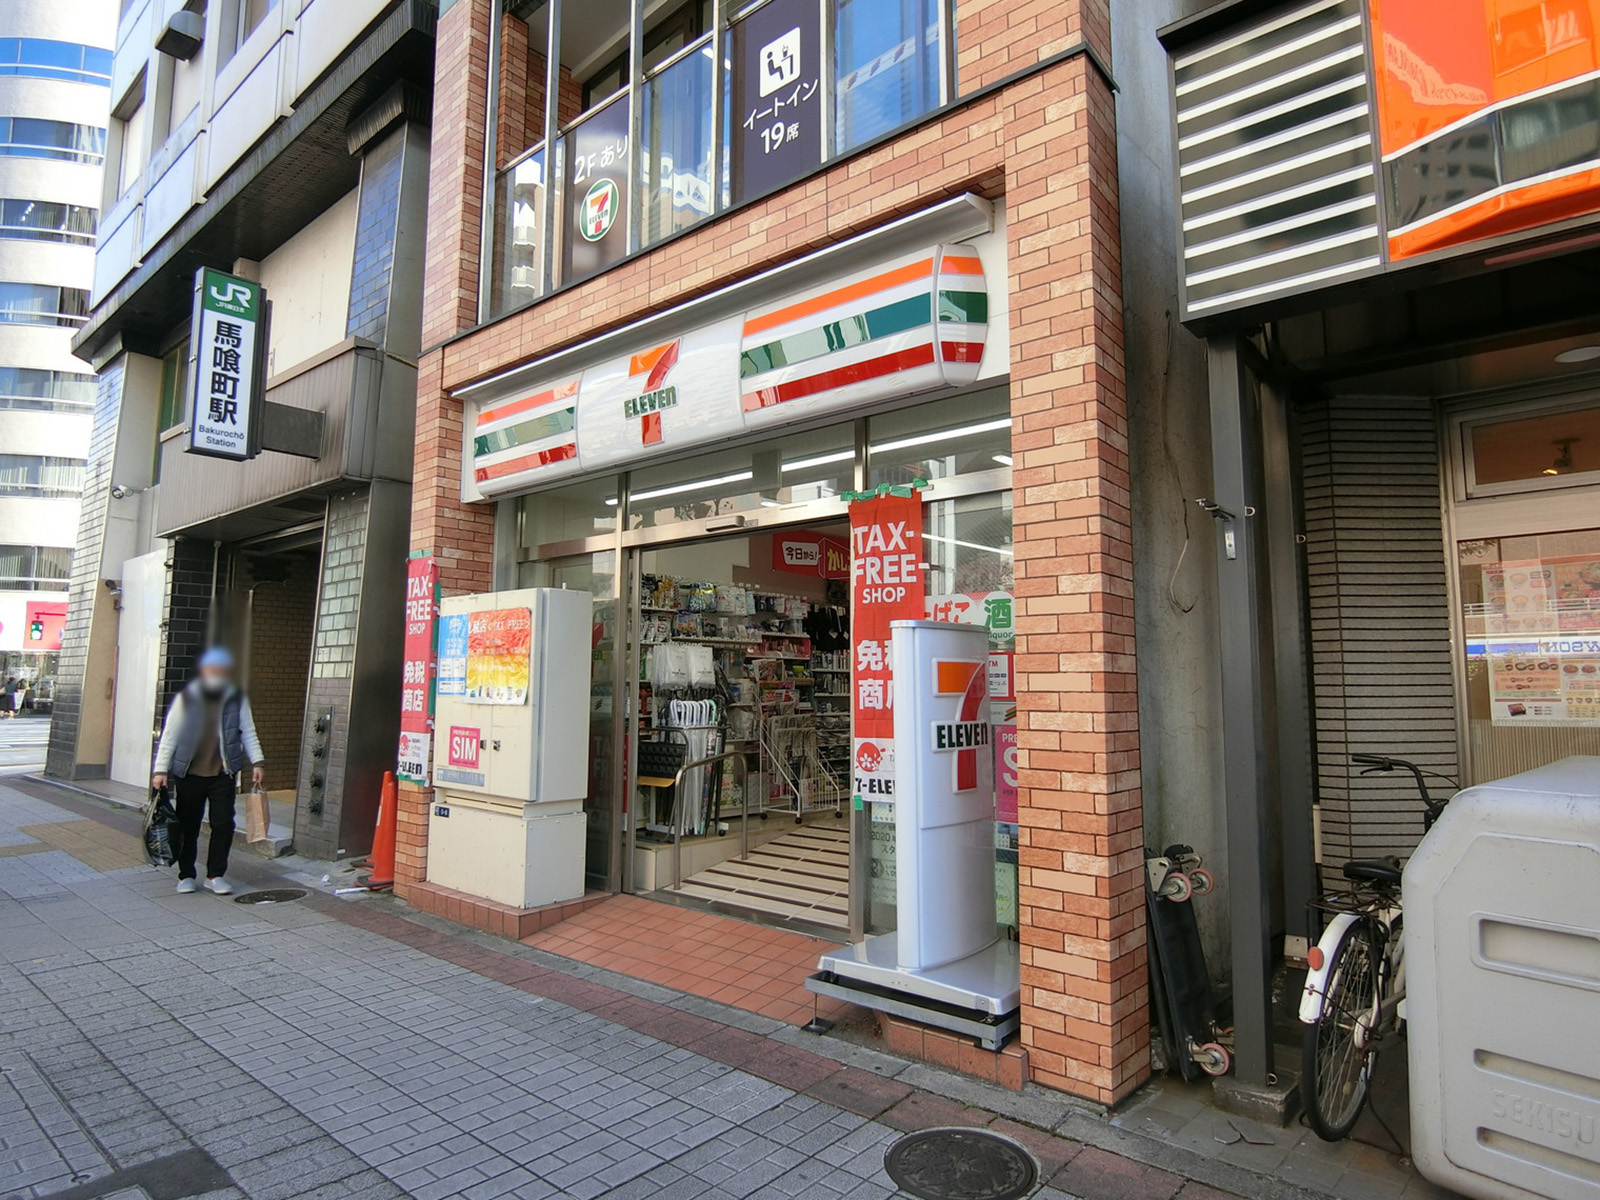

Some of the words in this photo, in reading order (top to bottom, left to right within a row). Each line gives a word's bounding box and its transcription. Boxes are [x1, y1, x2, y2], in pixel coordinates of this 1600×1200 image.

[742, 79, 818, 130] イートイン
[761, 121, 800, 154] 19席
[210, 282, 251, 308] JR
[208, 319, 242, 426] 馬喰町駅
[206, 436, 236, 449] Station
[854, 521, 915, 555] TAX-
[827, 548, 850, 571] かし
[854, 554, 917, 586] FREE
[407, 575, 433, 599] TAX-
[862, 586, 906, 604] SHOP
[406, 598, 432, 622] FREE
[924, 600, 972, 625] ばこ
[984, 598, 1012, 630] 酒
[408, 622, 426, 635] SHOP
[404, 660, 426, 684] 免税
[989, 660, 998, 668] TM
[402, 688, 425, 712] 商店
[452, 736, 478, 761] SIM
[855, 777, 896, 795] 7-ELE
